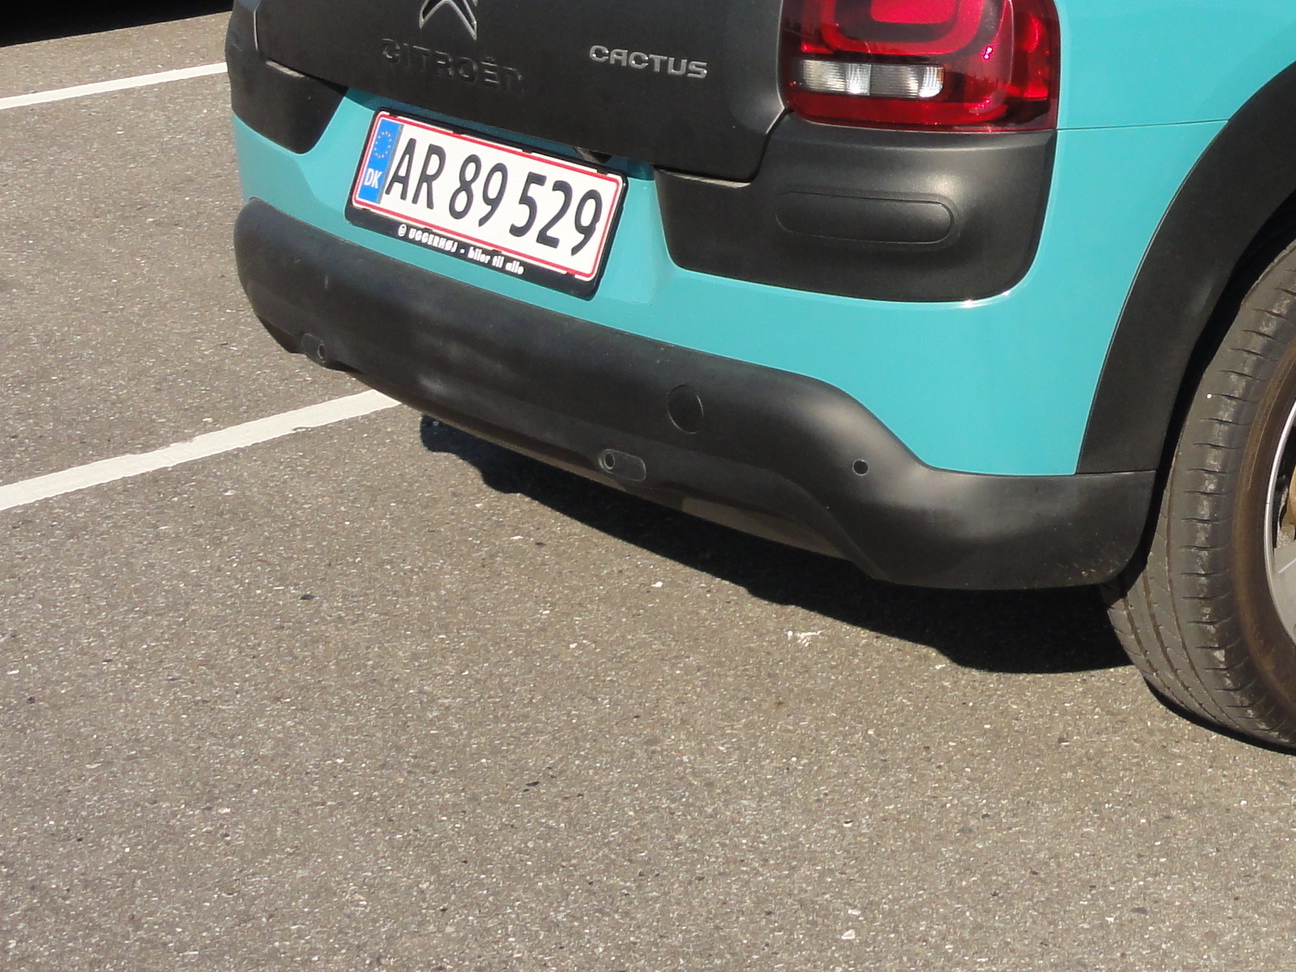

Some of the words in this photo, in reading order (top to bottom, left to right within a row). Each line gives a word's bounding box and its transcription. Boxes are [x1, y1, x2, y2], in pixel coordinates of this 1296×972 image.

[589, 45, 708, 79] CACTUS
[363, 167, 383, 190] DK
[385, 137, 446, 210] AR
[448, 154, 508, 228] 89
[509, 171, 602, 257] 529
